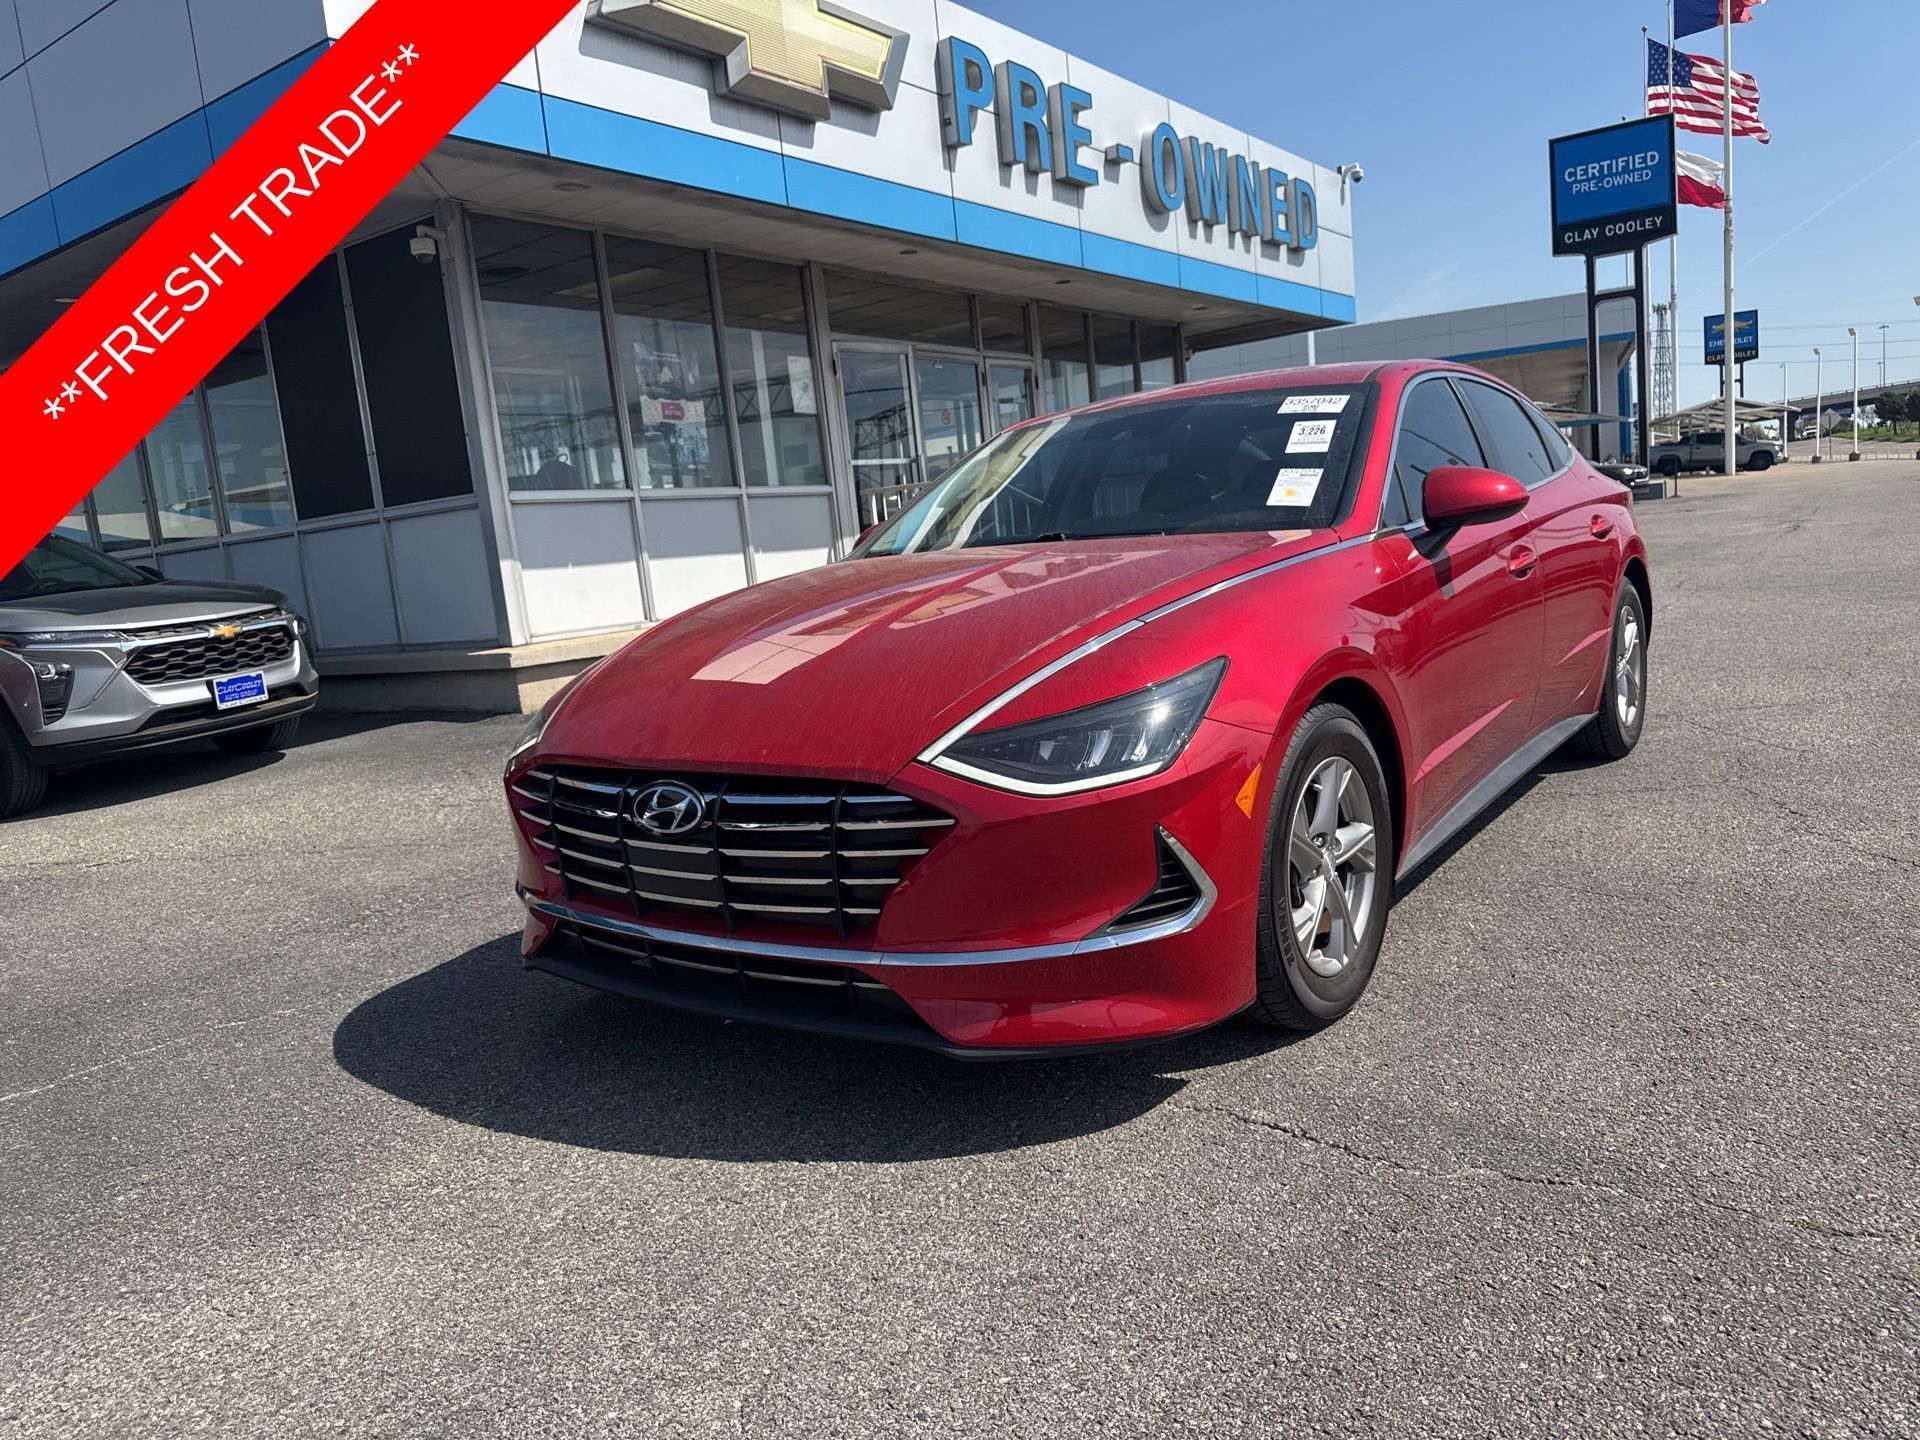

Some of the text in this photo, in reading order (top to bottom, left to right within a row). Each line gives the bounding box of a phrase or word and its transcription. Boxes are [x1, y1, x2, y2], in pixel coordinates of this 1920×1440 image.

[1564, 150, 1660, 183] CERTIFIED
[1572, 169, 1652, 195] PRE-OWNED
[1564, 215, 1663, 244] CLAY COOLEY
[1709, 336, 1753, 347] CHEOLET
[1732, 349, 1757, 358] OOLEY
